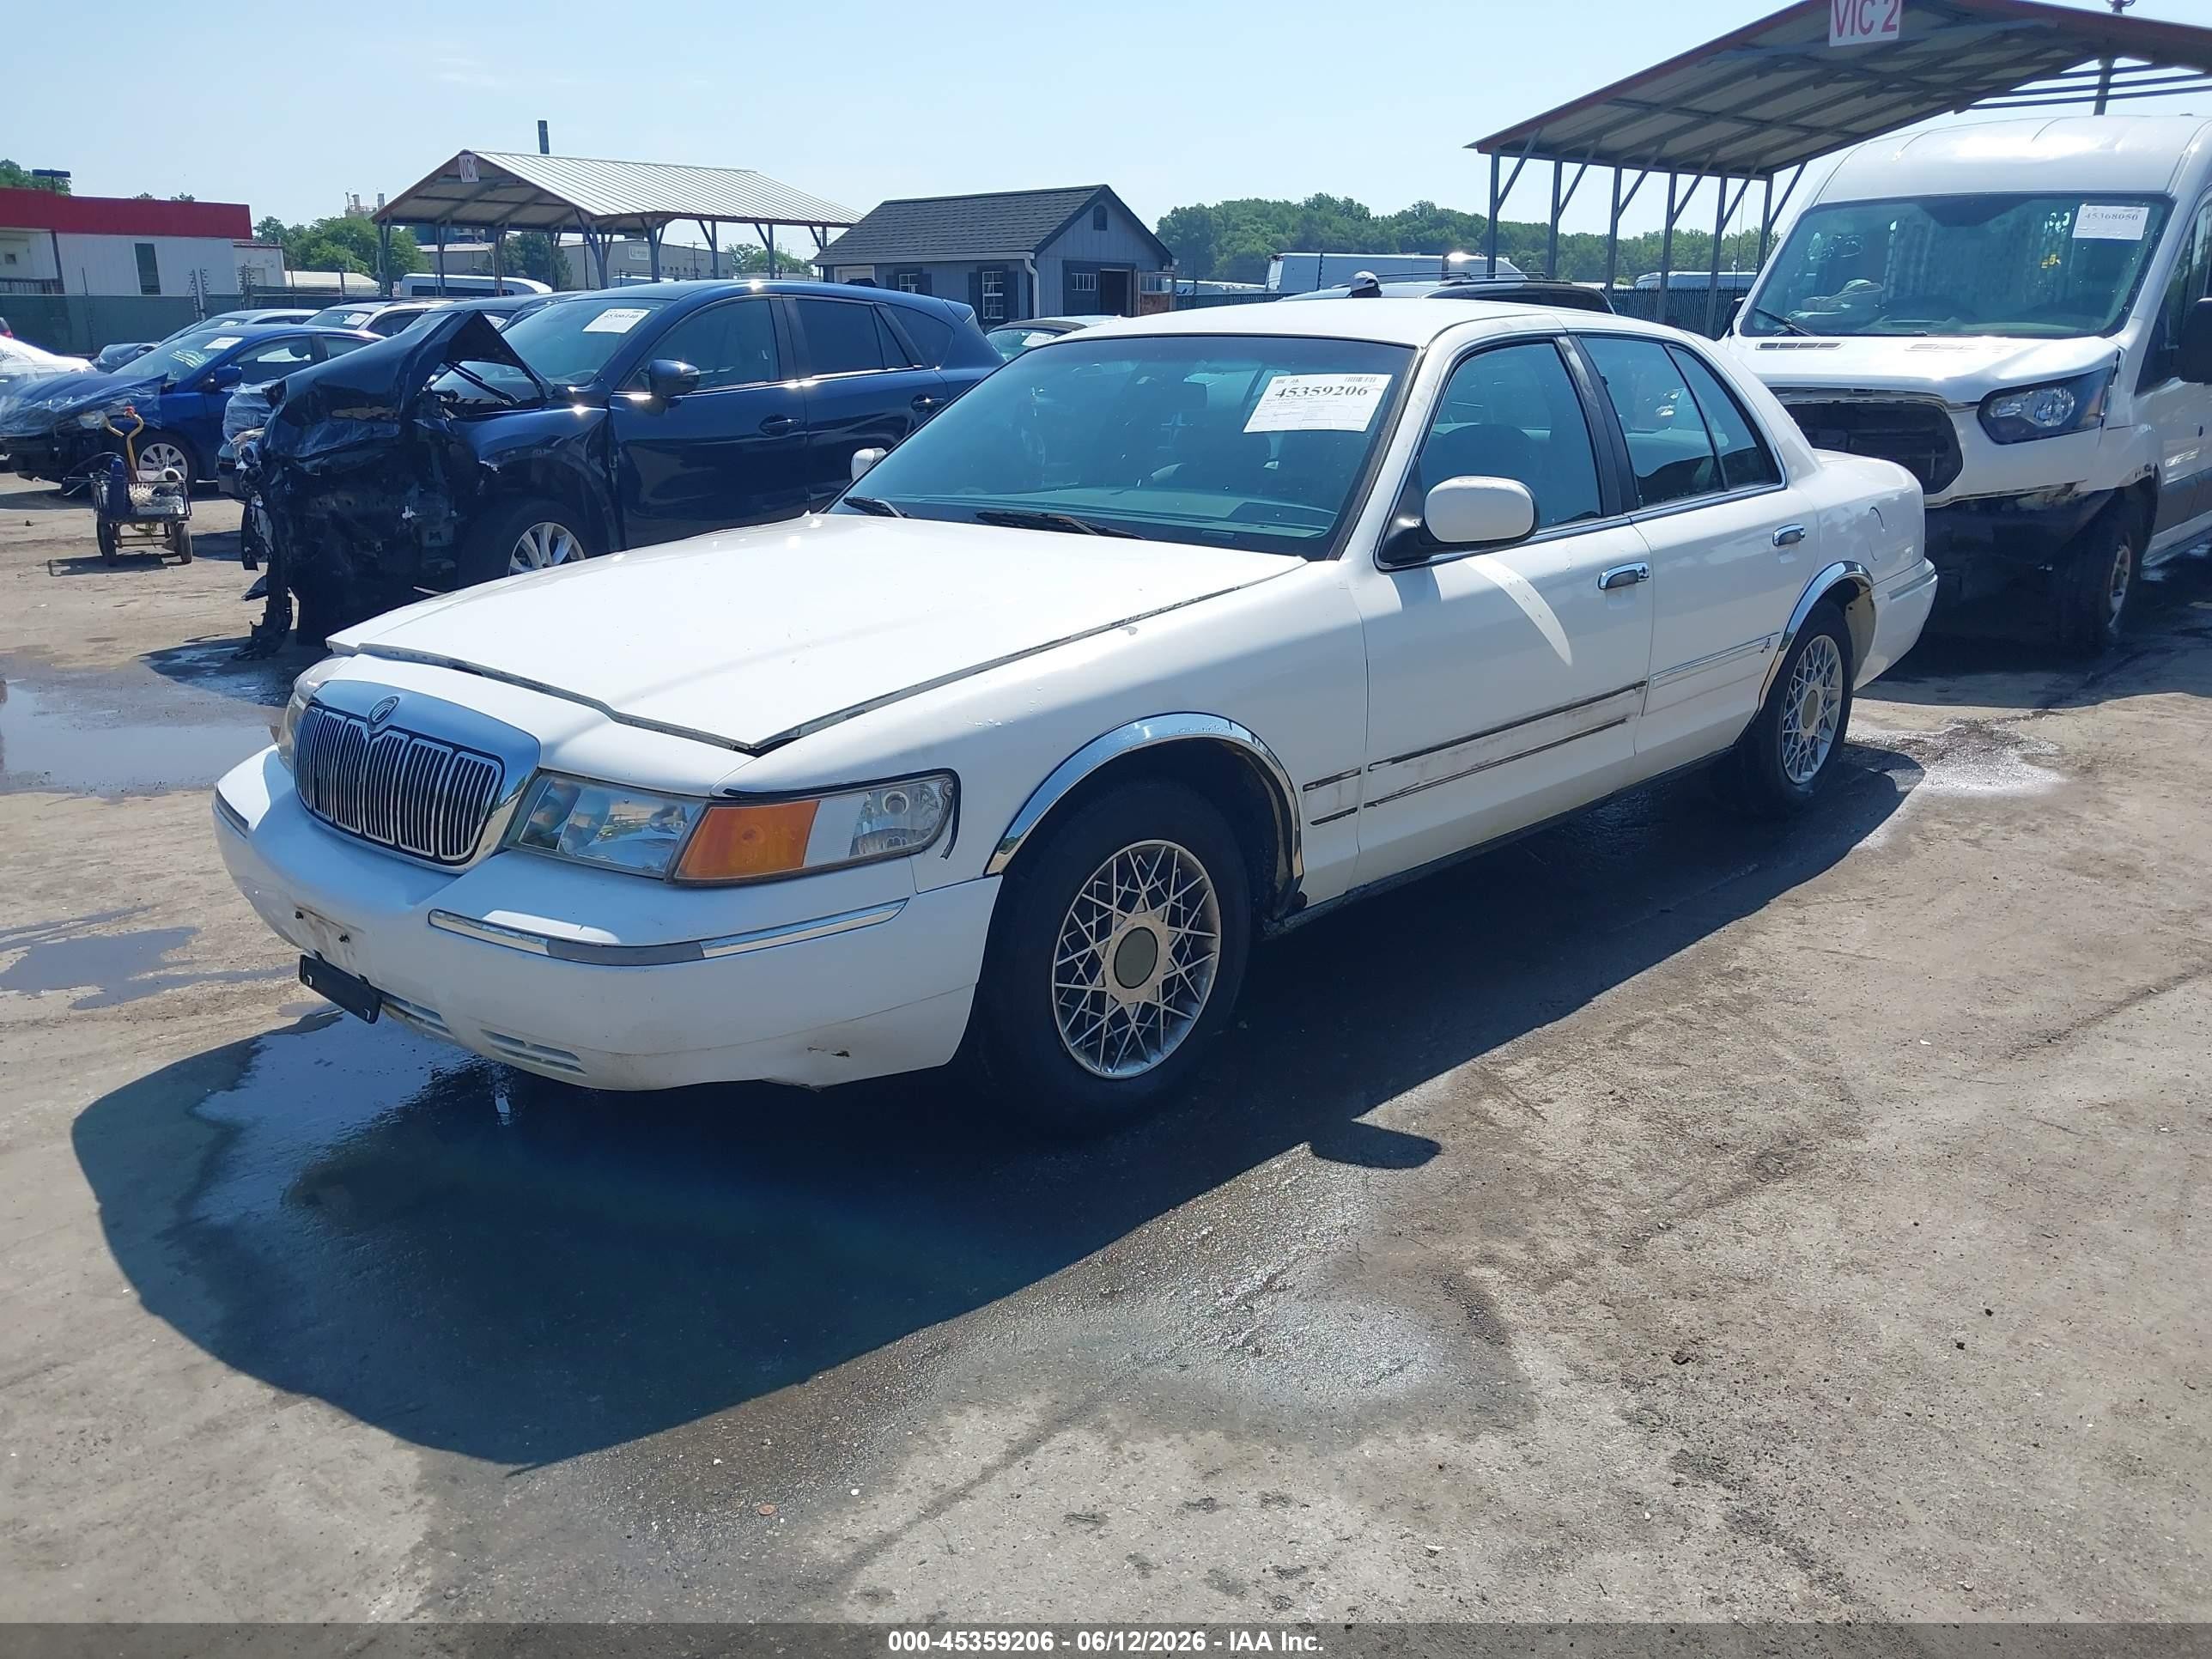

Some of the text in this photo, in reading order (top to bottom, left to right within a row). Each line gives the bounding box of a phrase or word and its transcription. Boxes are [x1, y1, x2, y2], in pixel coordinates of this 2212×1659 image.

[1833, 0, 1899, 37] VIC 2
[1274, 386, 1369, 398] 45359206
